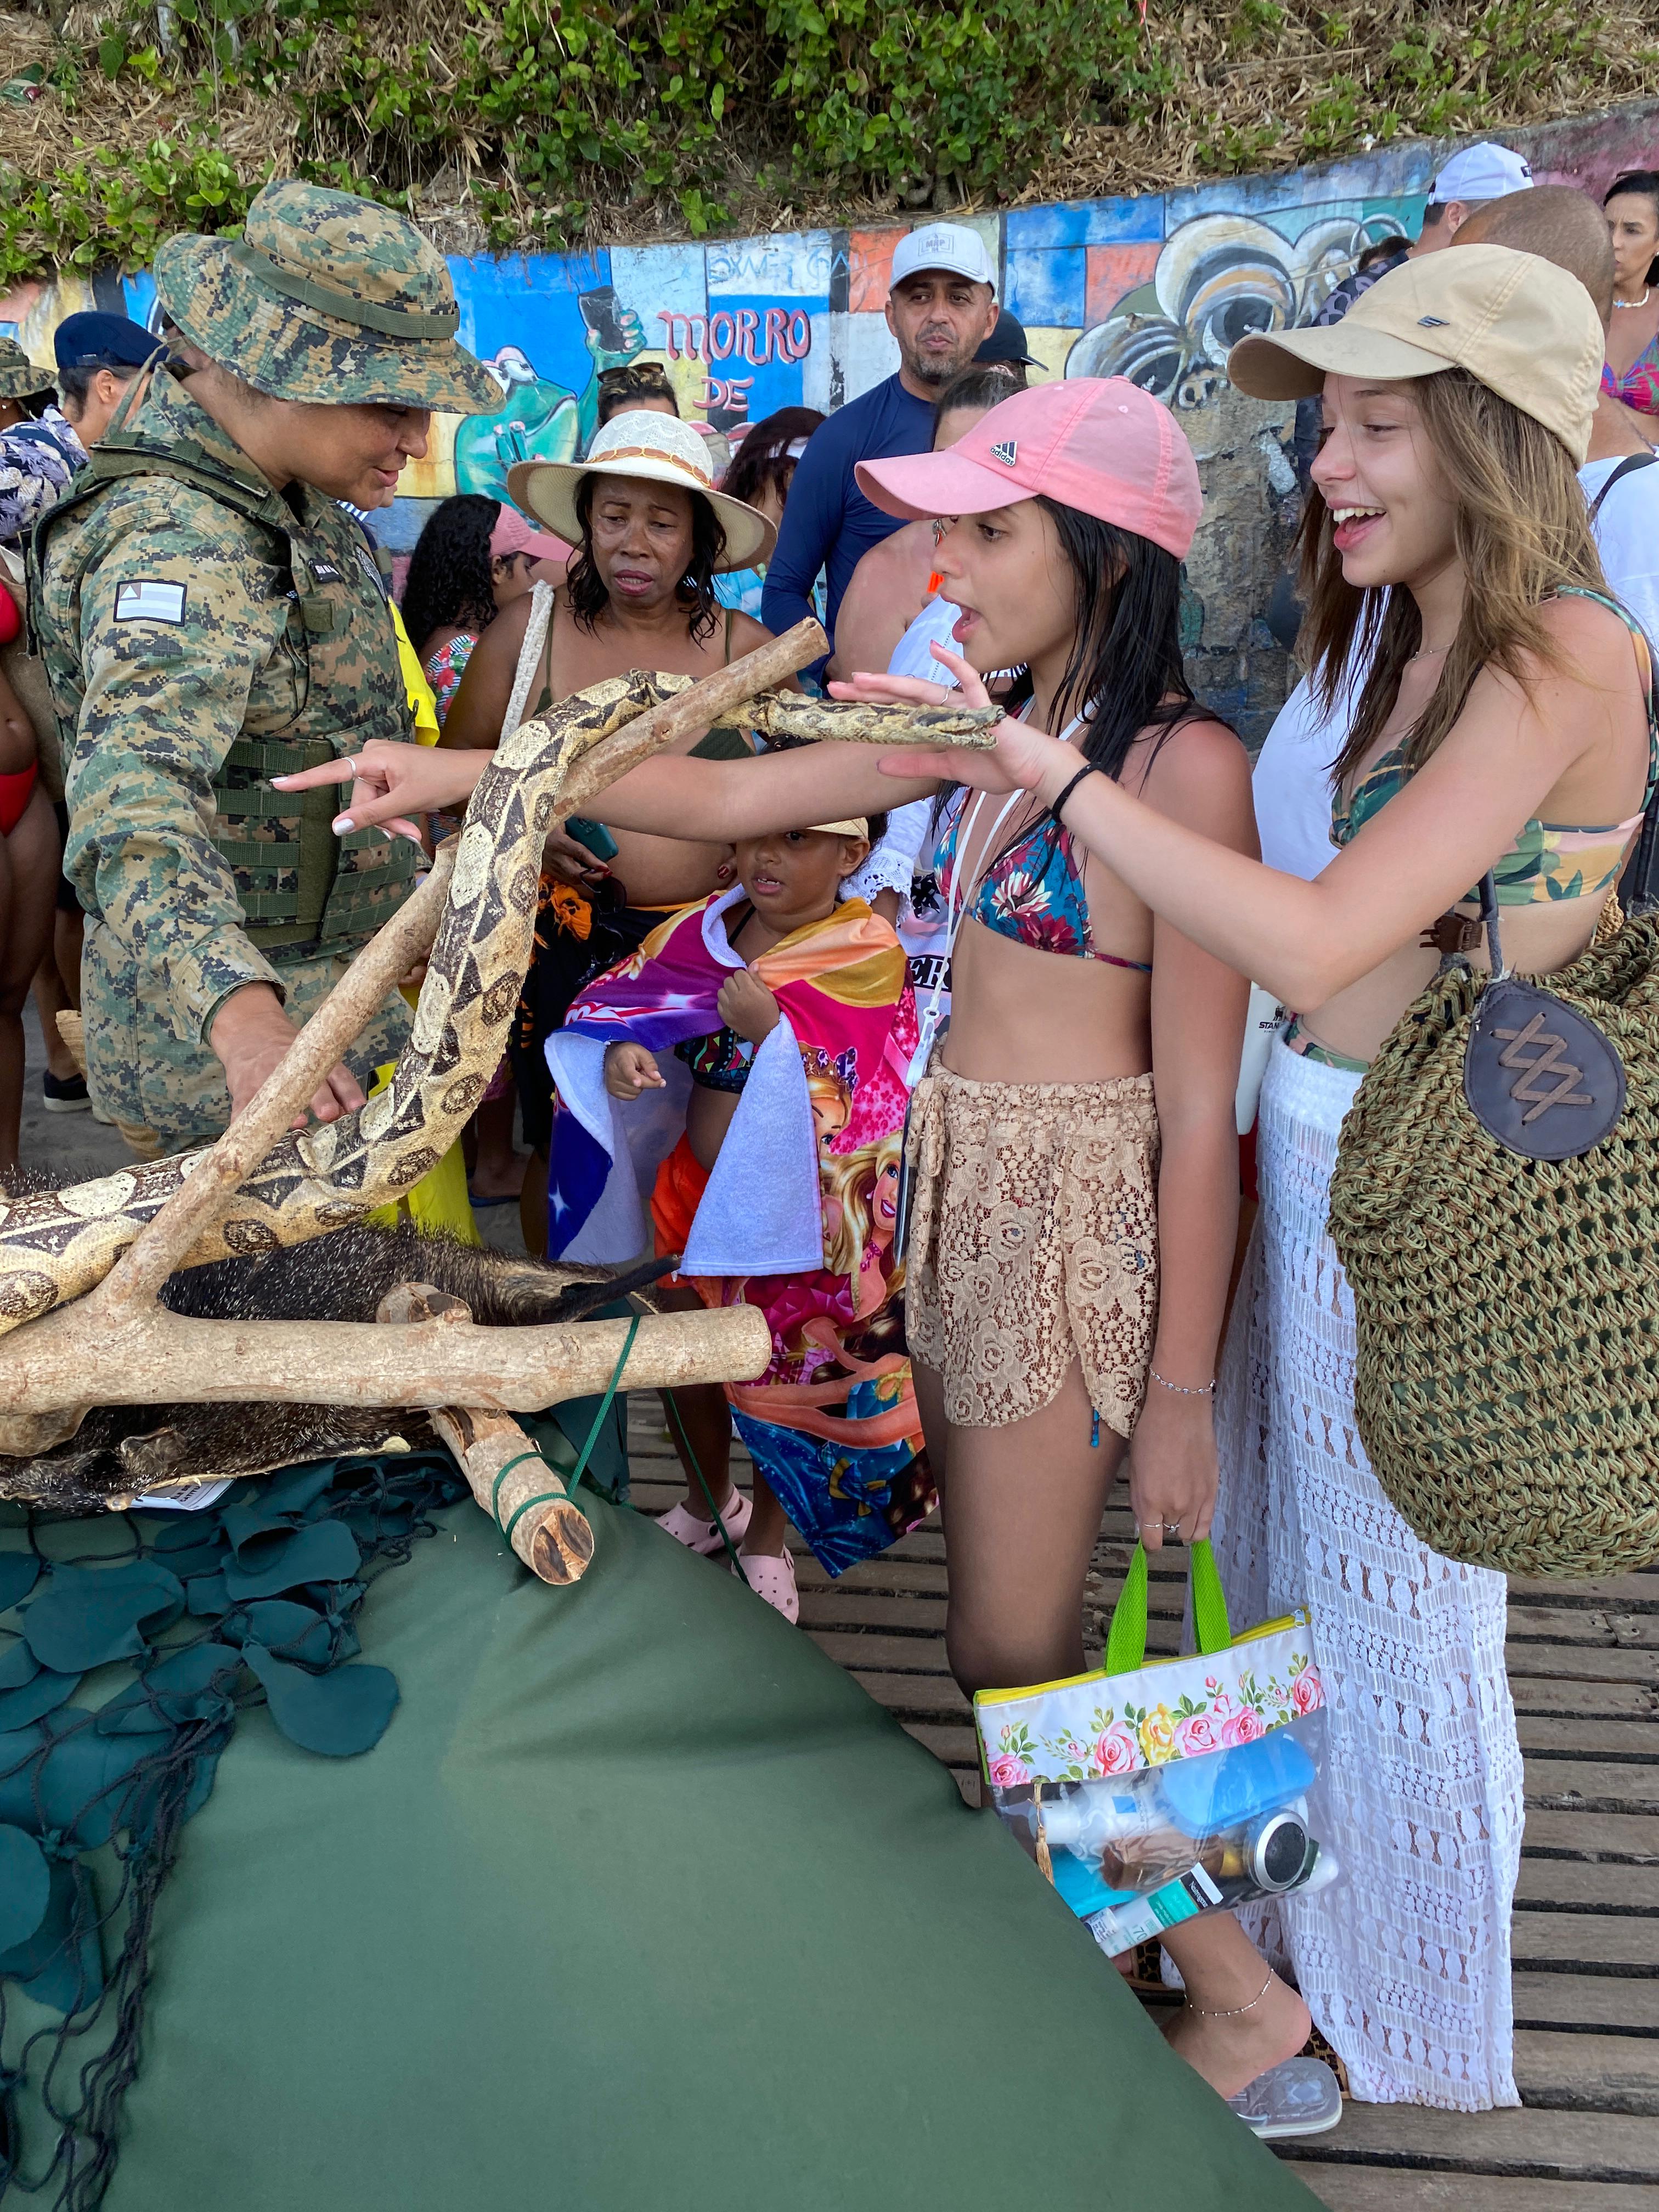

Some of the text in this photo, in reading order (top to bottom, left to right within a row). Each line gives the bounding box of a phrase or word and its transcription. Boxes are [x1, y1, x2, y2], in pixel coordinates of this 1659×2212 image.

[656, 308, 811, 366] MORRO
[692, 376, 755, 411] DE
[990, 447, 1015, 465] adidas
[1188, 1880, 1209, 1908] Neutrogena
[1133, 1926, 1147, 1940] 70
